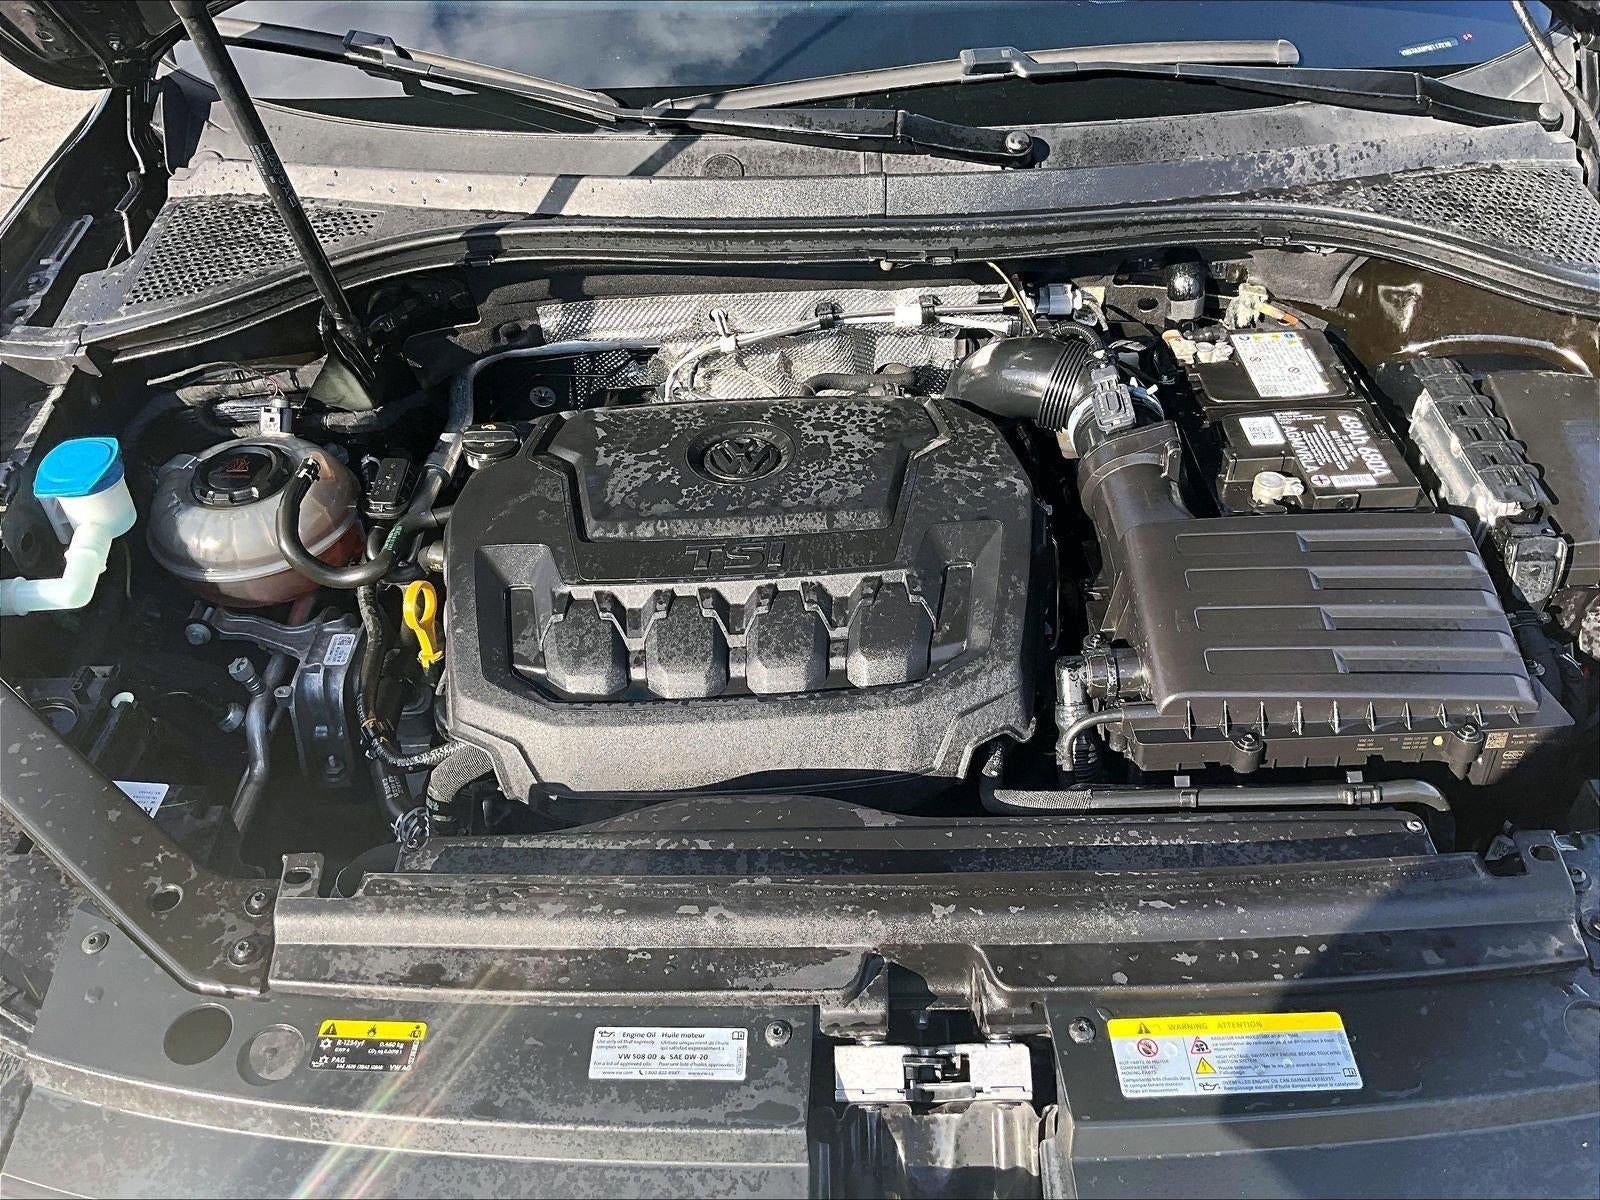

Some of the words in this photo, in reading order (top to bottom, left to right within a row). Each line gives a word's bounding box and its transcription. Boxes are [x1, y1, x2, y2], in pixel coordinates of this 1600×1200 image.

[1337, 416, 1370, 445] 68Ah
[1357, 447, 1392, 477] 680A
[685, 540, 786, 572] TSI
[1217, 1020, 1262, 1029] ATTENTION
[622, 1031, 645, 1039] Engine
[336, 1040, 365, 1048] R-1234yf
